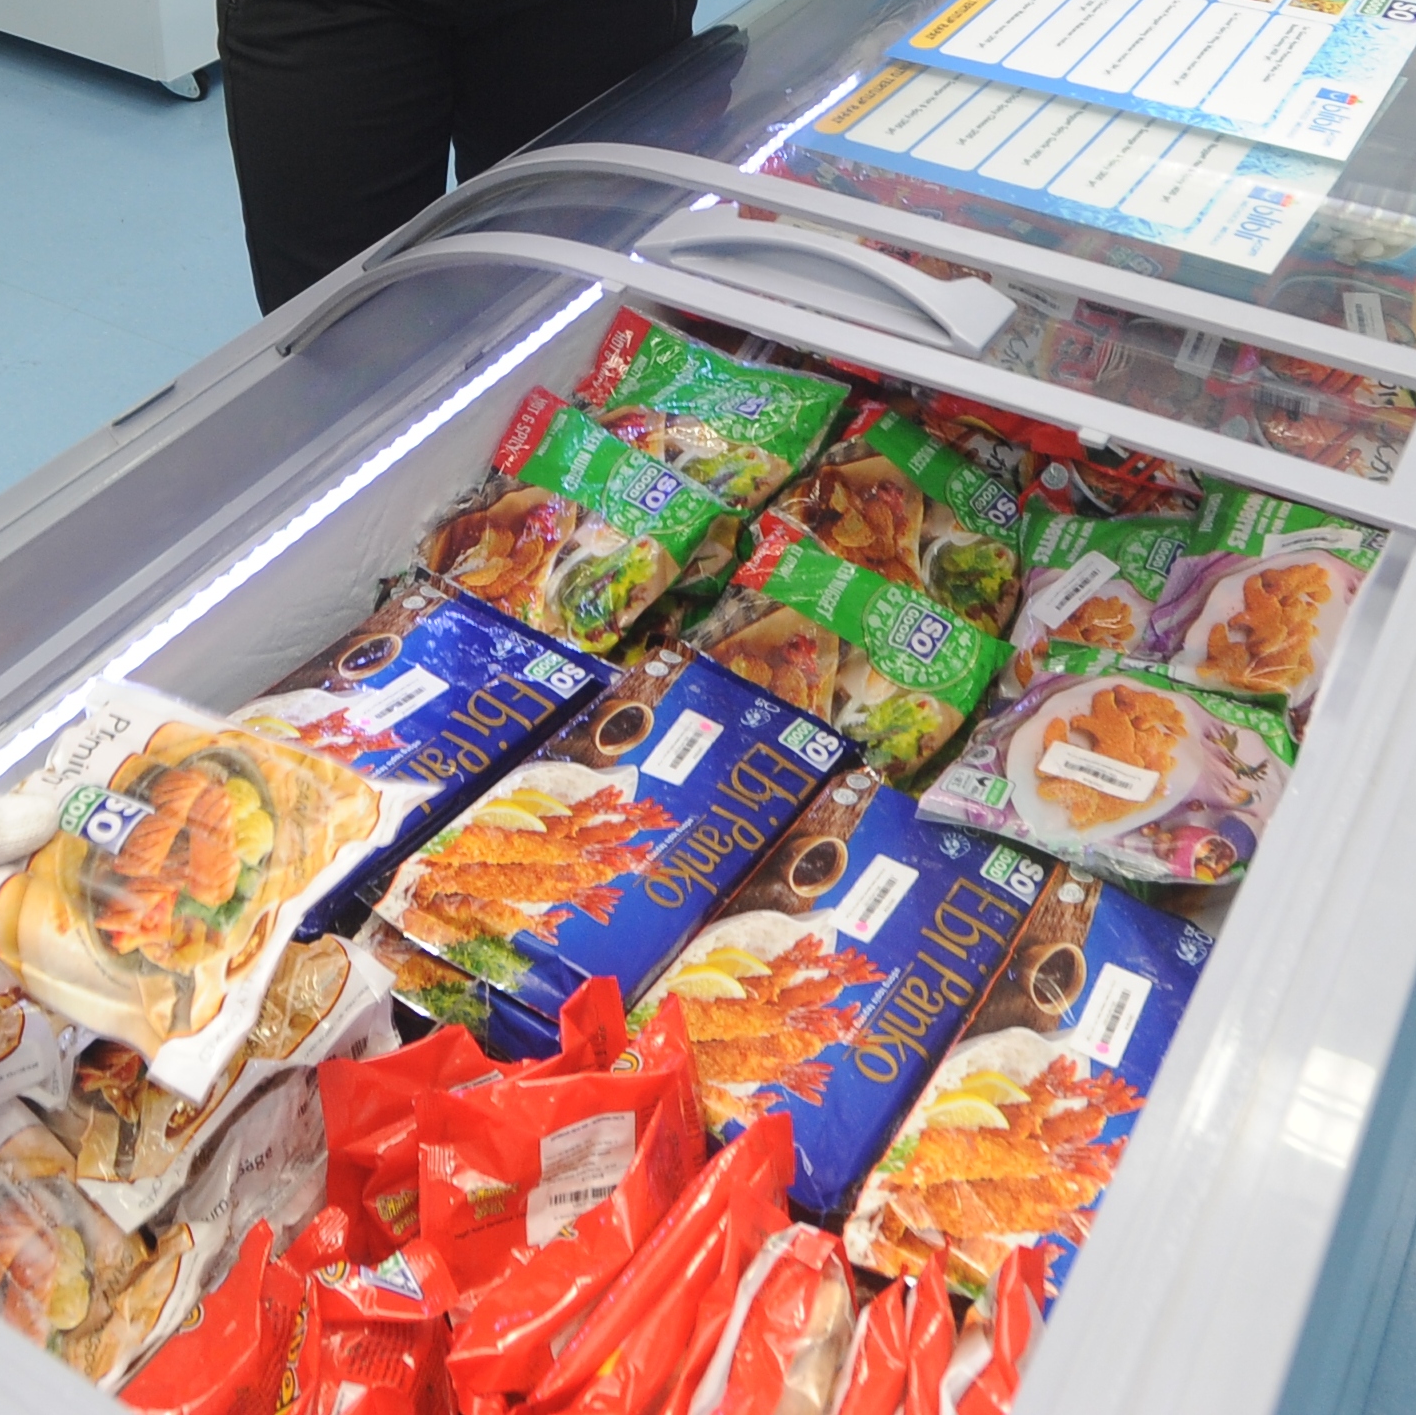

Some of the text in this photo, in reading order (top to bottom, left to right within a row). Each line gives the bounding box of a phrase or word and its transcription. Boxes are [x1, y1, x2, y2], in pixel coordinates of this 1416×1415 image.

[1306, 102, 1354, 135] blibli
[1232, 204, 1292, 243] blibli
[531, 397, 549, 418] HOT
[629, 466, 658, 501] GOOD
[645, 475, 680, 511] SO
[973, 483, 999, 511] GOOD
[987, 496, 1019, 526] SO
[1151, 539, 1177, 570] GOOD
[815, 578, 848, 623] NUGGET
[895, 607, 921, 645] GOOD
[912, 616, 947, 655] SO
[533, 653, 564, 678] GOOD
[550, 662, 587, 690] SO
[450, 673, 556, 751] Ebi
[785, 721, 814, 748] GOOD
[804, 731, 840, 763] SO
[97, 795, 134, 845] SO
[644, 742, 818, 909] Ebi Panko
[988, 847, 1017, 879] GOOD
[1009, 859, 1045, 895] SO
[853, 876, 1023, 1085] Ebi Panko
